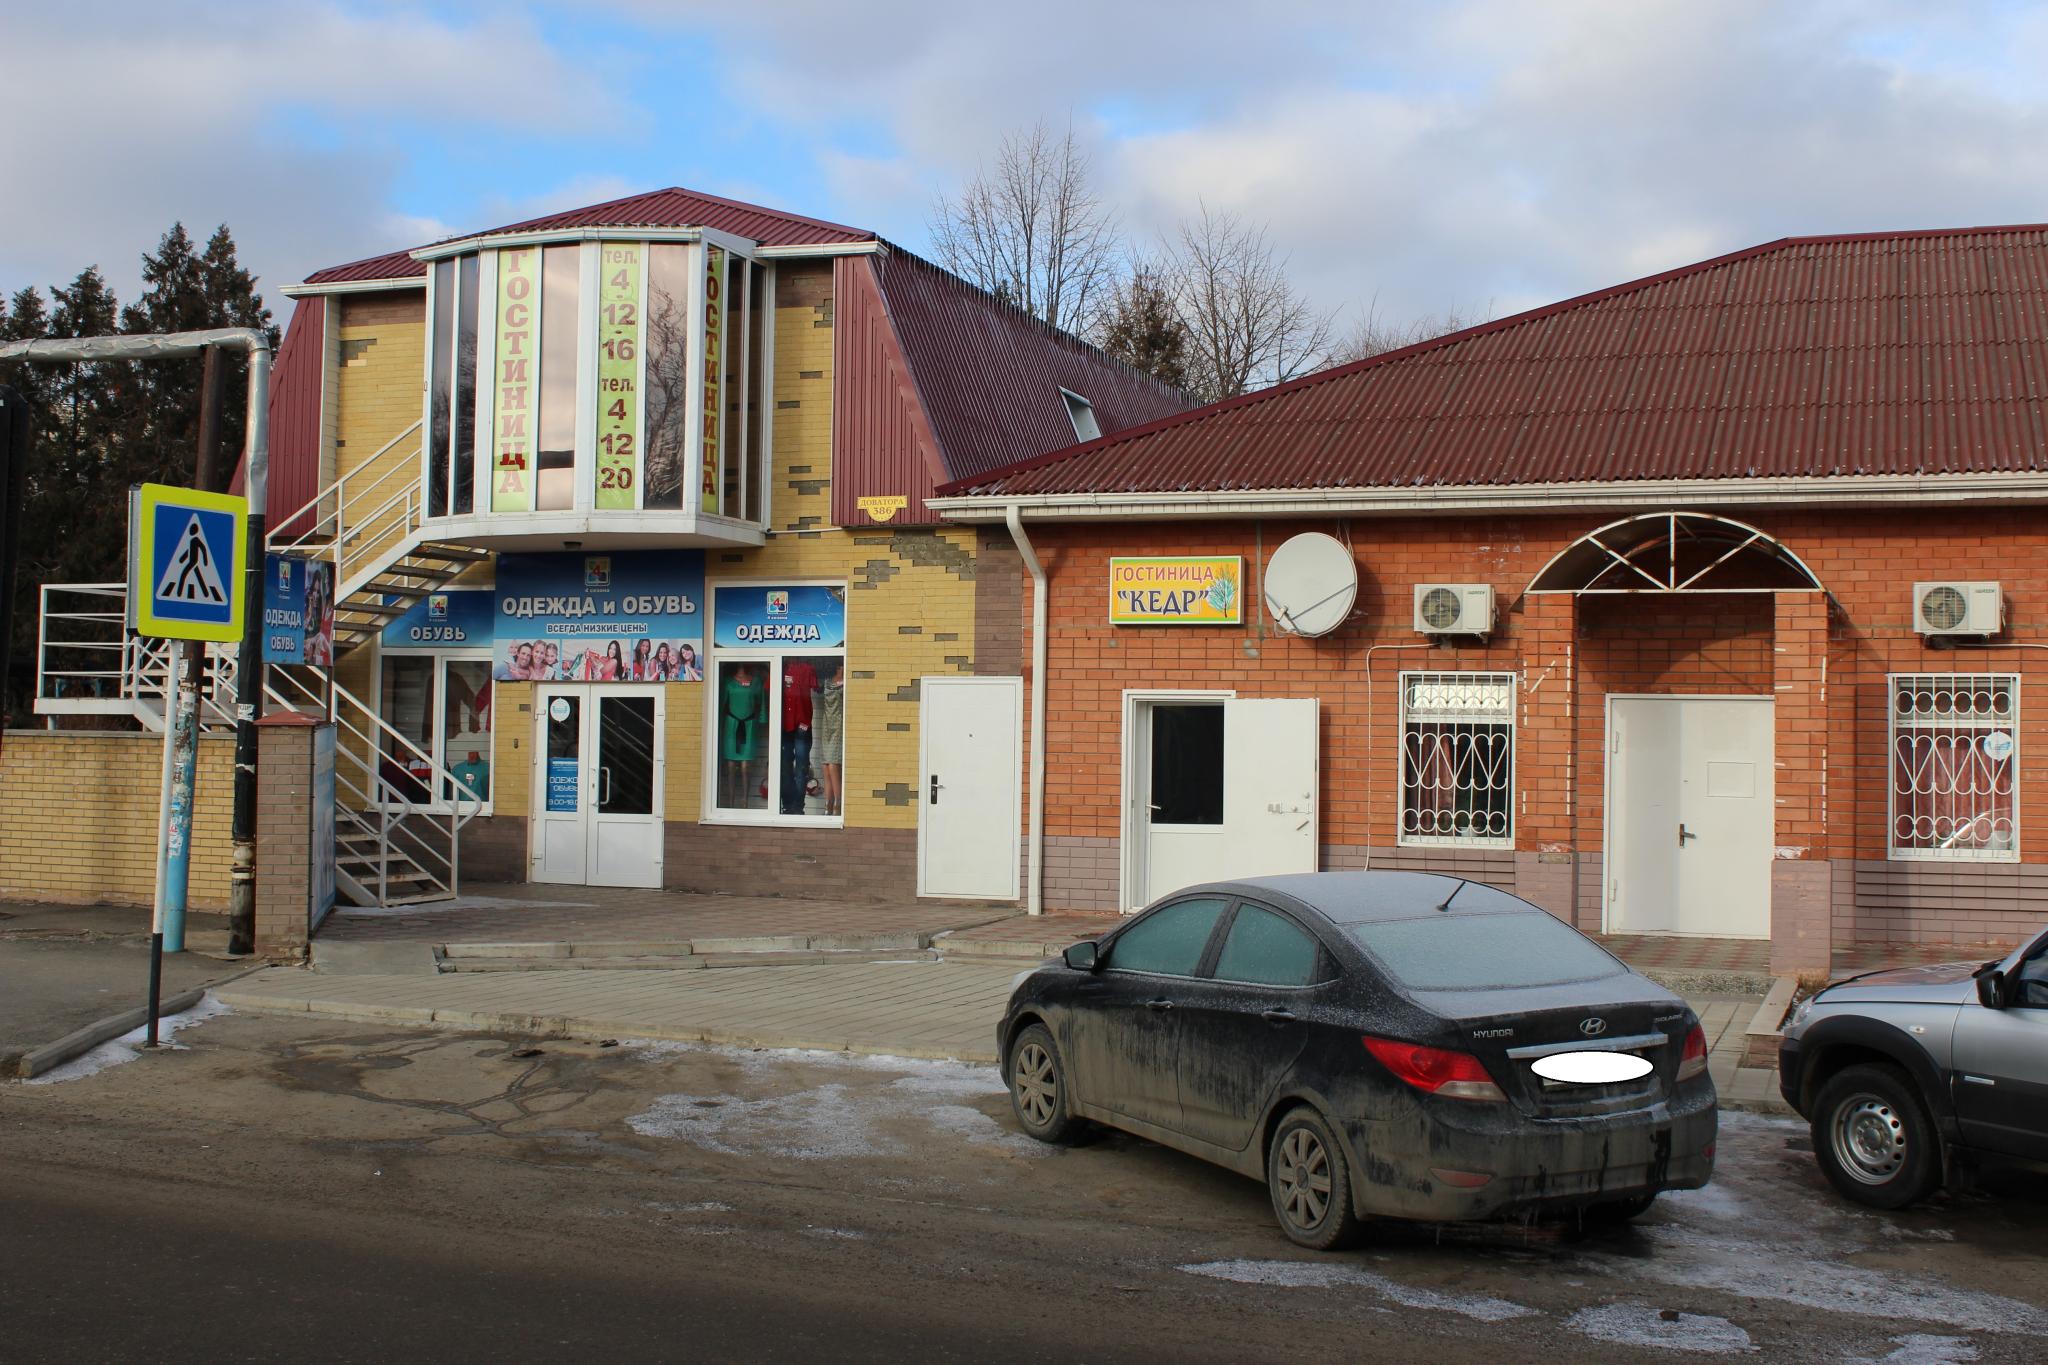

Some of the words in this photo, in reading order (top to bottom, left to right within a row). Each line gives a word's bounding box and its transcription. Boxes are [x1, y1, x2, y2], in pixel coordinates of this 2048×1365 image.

[605, 249, 637, 265] тел.
[498, 249, 530, 494] ГОСТИНИЦА
[602, 377, 634, 392] тел.
[1115, 566, 1214, 584] ГОСТИНИЦА
[502, 596, 597, 618] ОДЕЖДА
[603, 600, 616, 615] и
[622, 595, 696, 615] ОБУВЬ
[265, 608, 302, 629] ОДЕЖДА
[410, 627, 466, 641] ОБУВЬ
[547, 624, 582, 634] ВСЕГДА
[583, 624, 619, 633] НИЗКИЕ
[620, 623, 647, 634] ЦЕНЫ
[735, 624, 820, 643] ОДЕЖДА
[271, 636, 296, 652] ОБУВЬ
[1473, 1028, 1514, 1038] HYUNDAI
